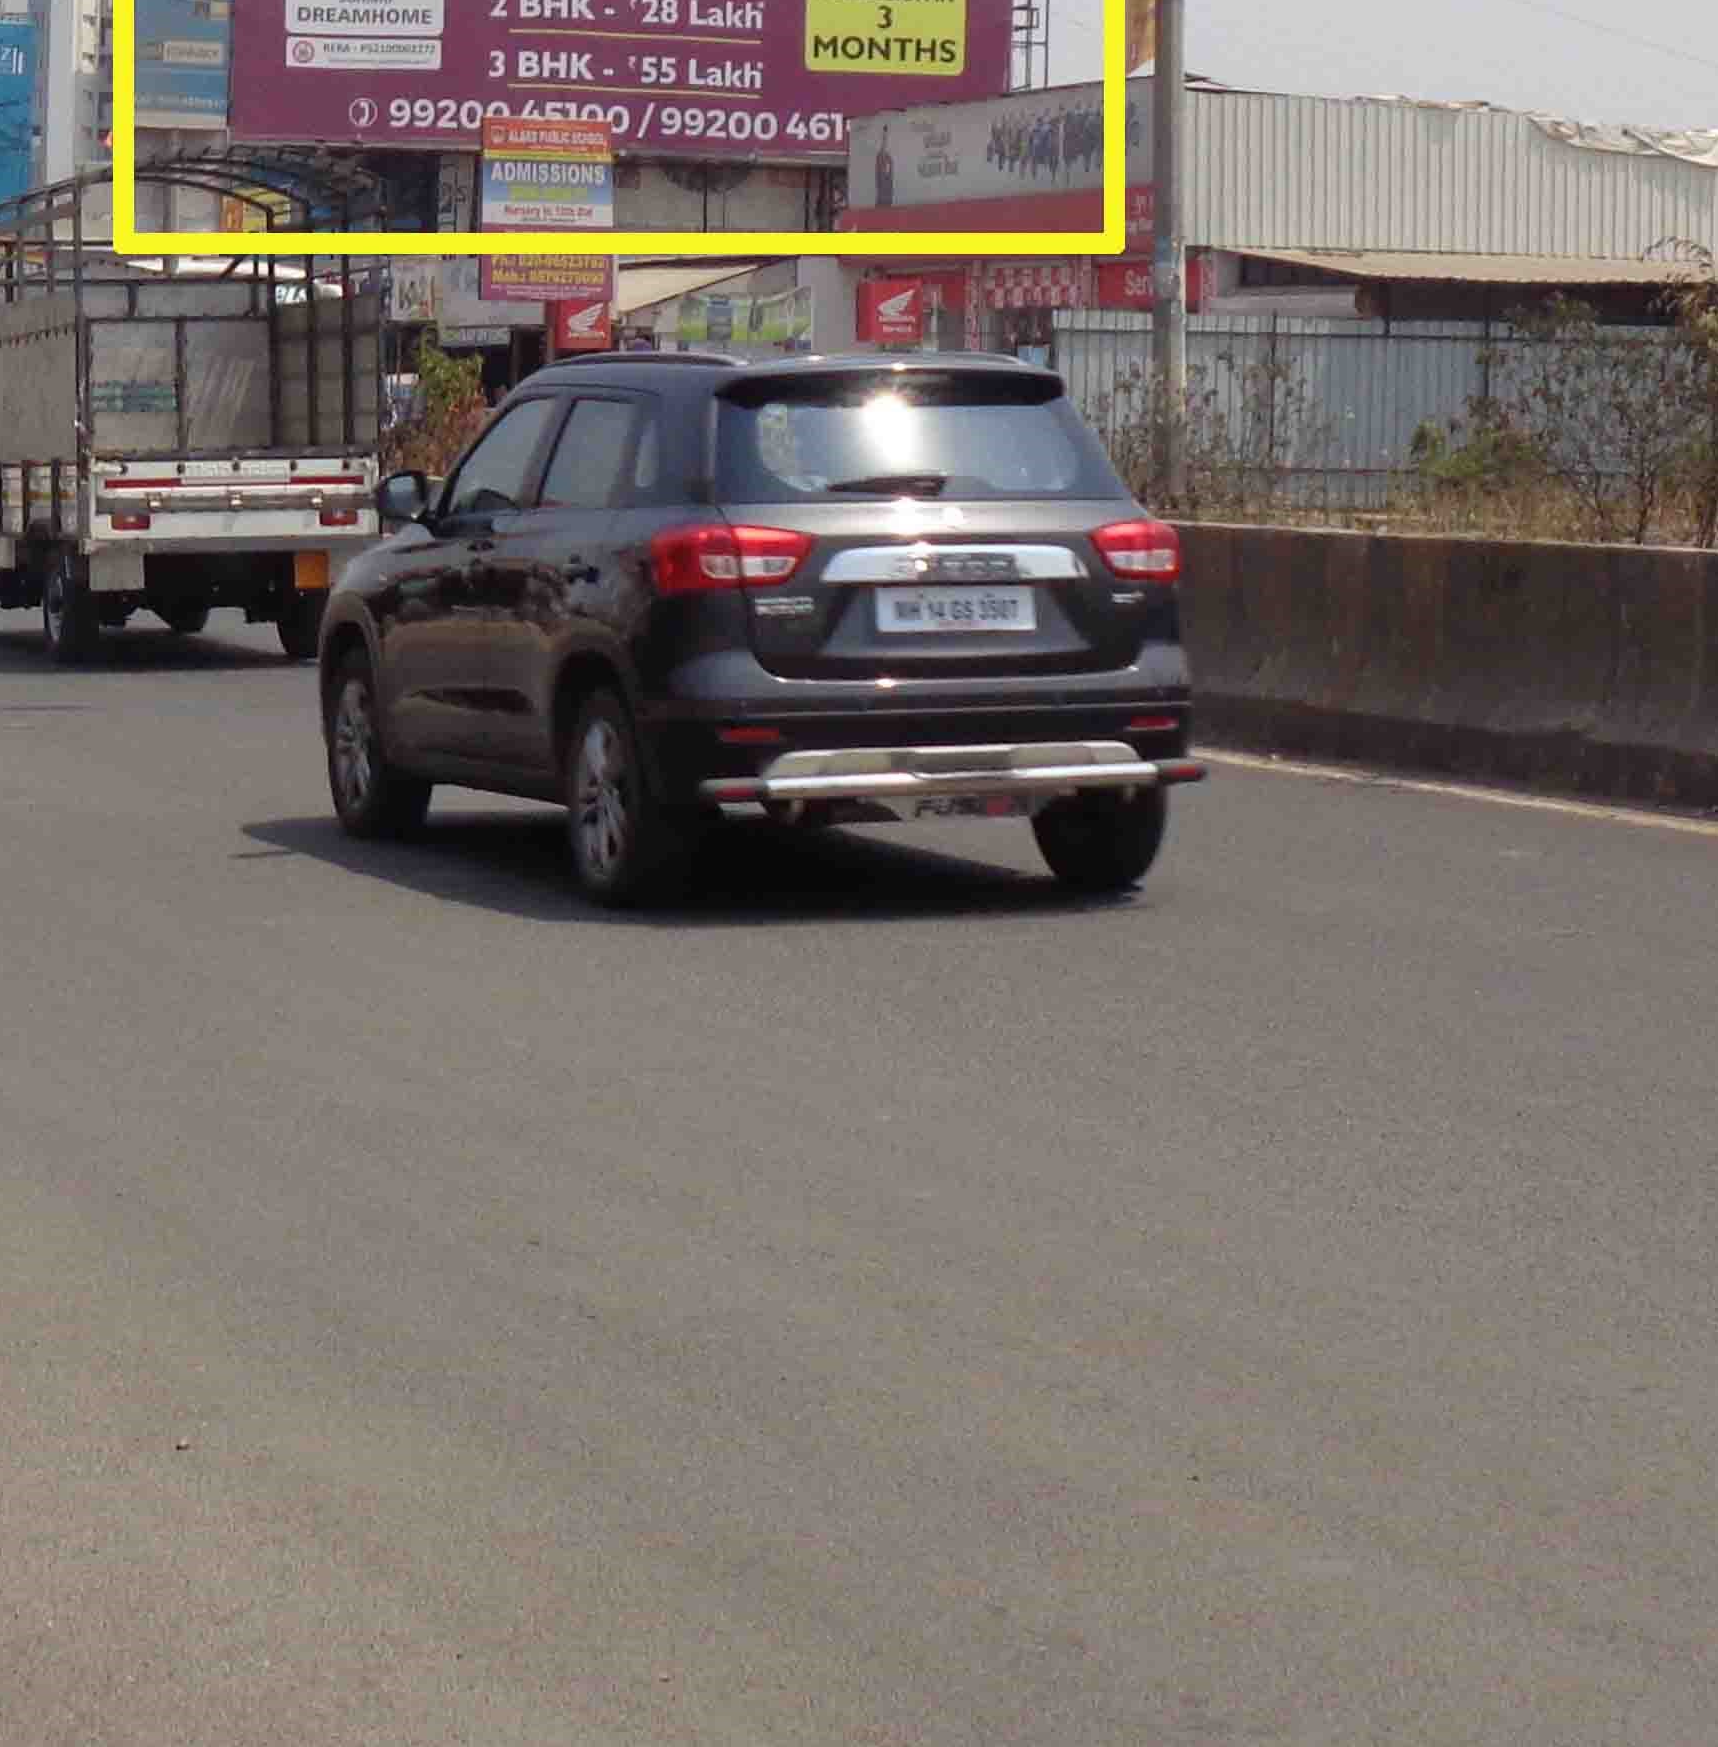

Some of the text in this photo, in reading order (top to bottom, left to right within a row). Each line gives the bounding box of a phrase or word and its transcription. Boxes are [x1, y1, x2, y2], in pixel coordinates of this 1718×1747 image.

[297, 6, 432, 25] DREAMHOME
[876, 5, 894, 30] 3
[812, 35, 958, 64] MONTHS
[488, 50, 507, 78] 3
[518, 51, 595, 80] BHK
[661, 107, 778, 142] 99200
[786, 112, 851, 142] 461
[491, 162, 605, 184] ADMISSIONS
